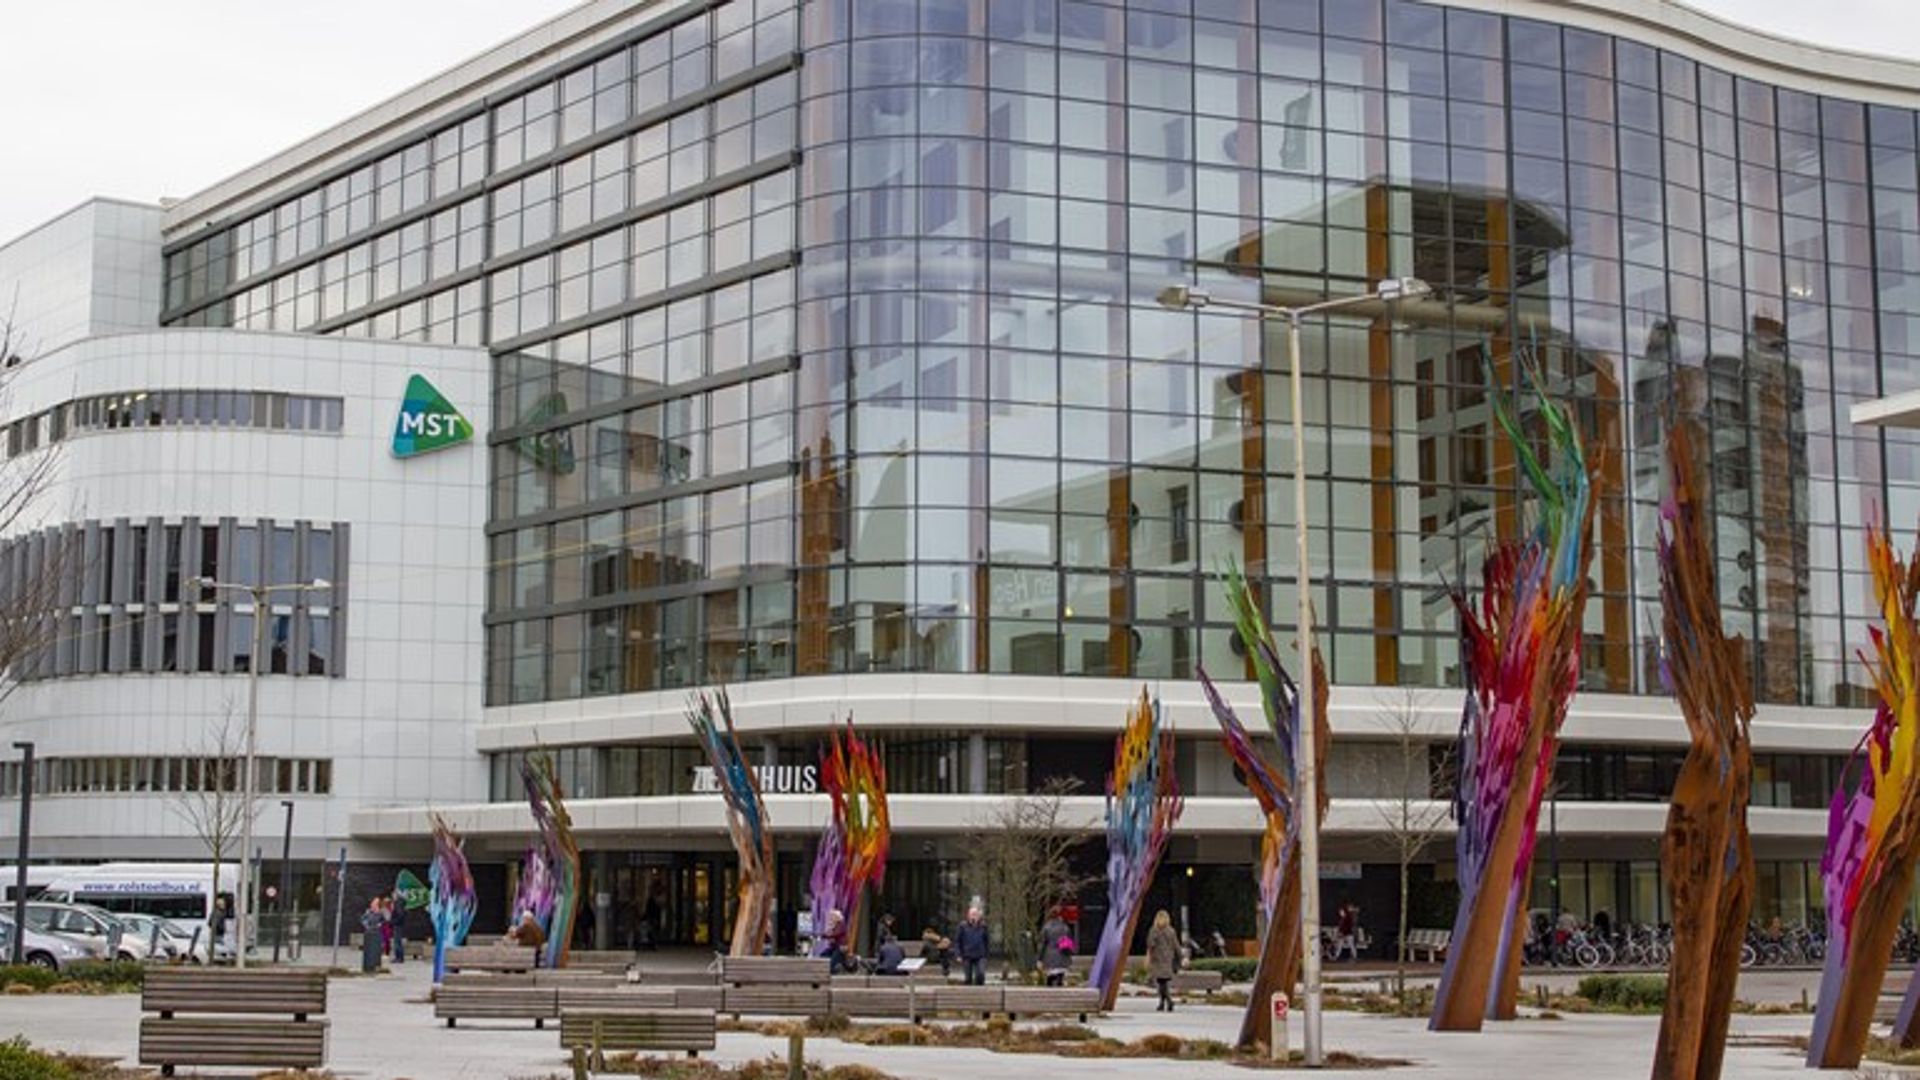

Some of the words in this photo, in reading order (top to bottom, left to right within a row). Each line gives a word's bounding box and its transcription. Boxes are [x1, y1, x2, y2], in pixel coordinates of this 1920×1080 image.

[402, 411, 460, 436] MST
[692, 765, 817, 792] ZIEHUIS
[83, 882, 200, 893] www.rolstoelbus.nl
